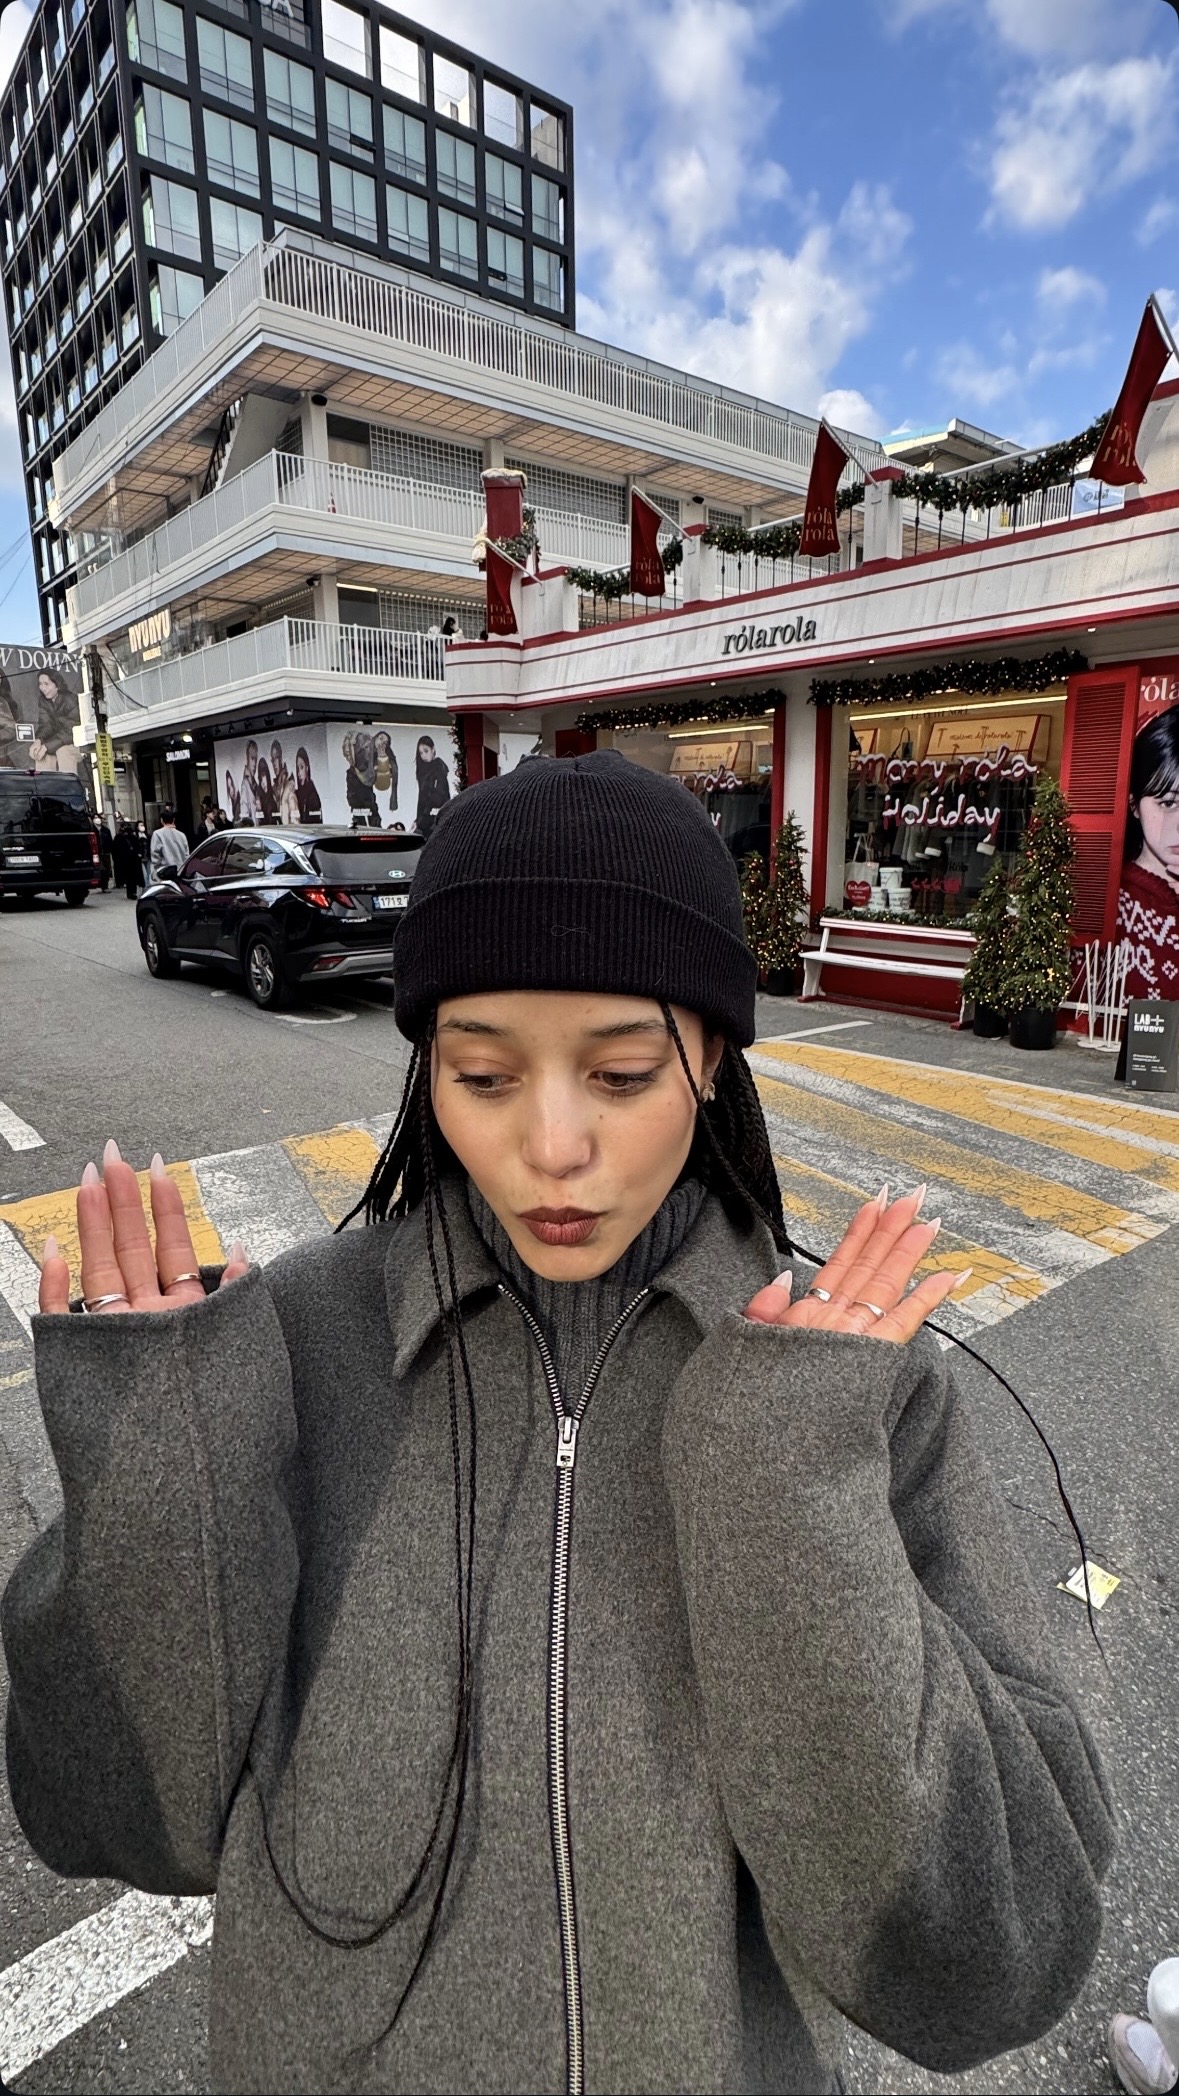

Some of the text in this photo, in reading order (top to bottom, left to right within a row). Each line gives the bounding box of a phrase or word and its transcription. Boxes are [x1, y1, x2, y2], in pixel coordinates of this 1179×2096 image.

[806, 506, 832, 525] róla
[805, 525, 835, 541] rola
[721, 615, 817, 655] rólarola
[882, 793, 1001, 845] Holiday
